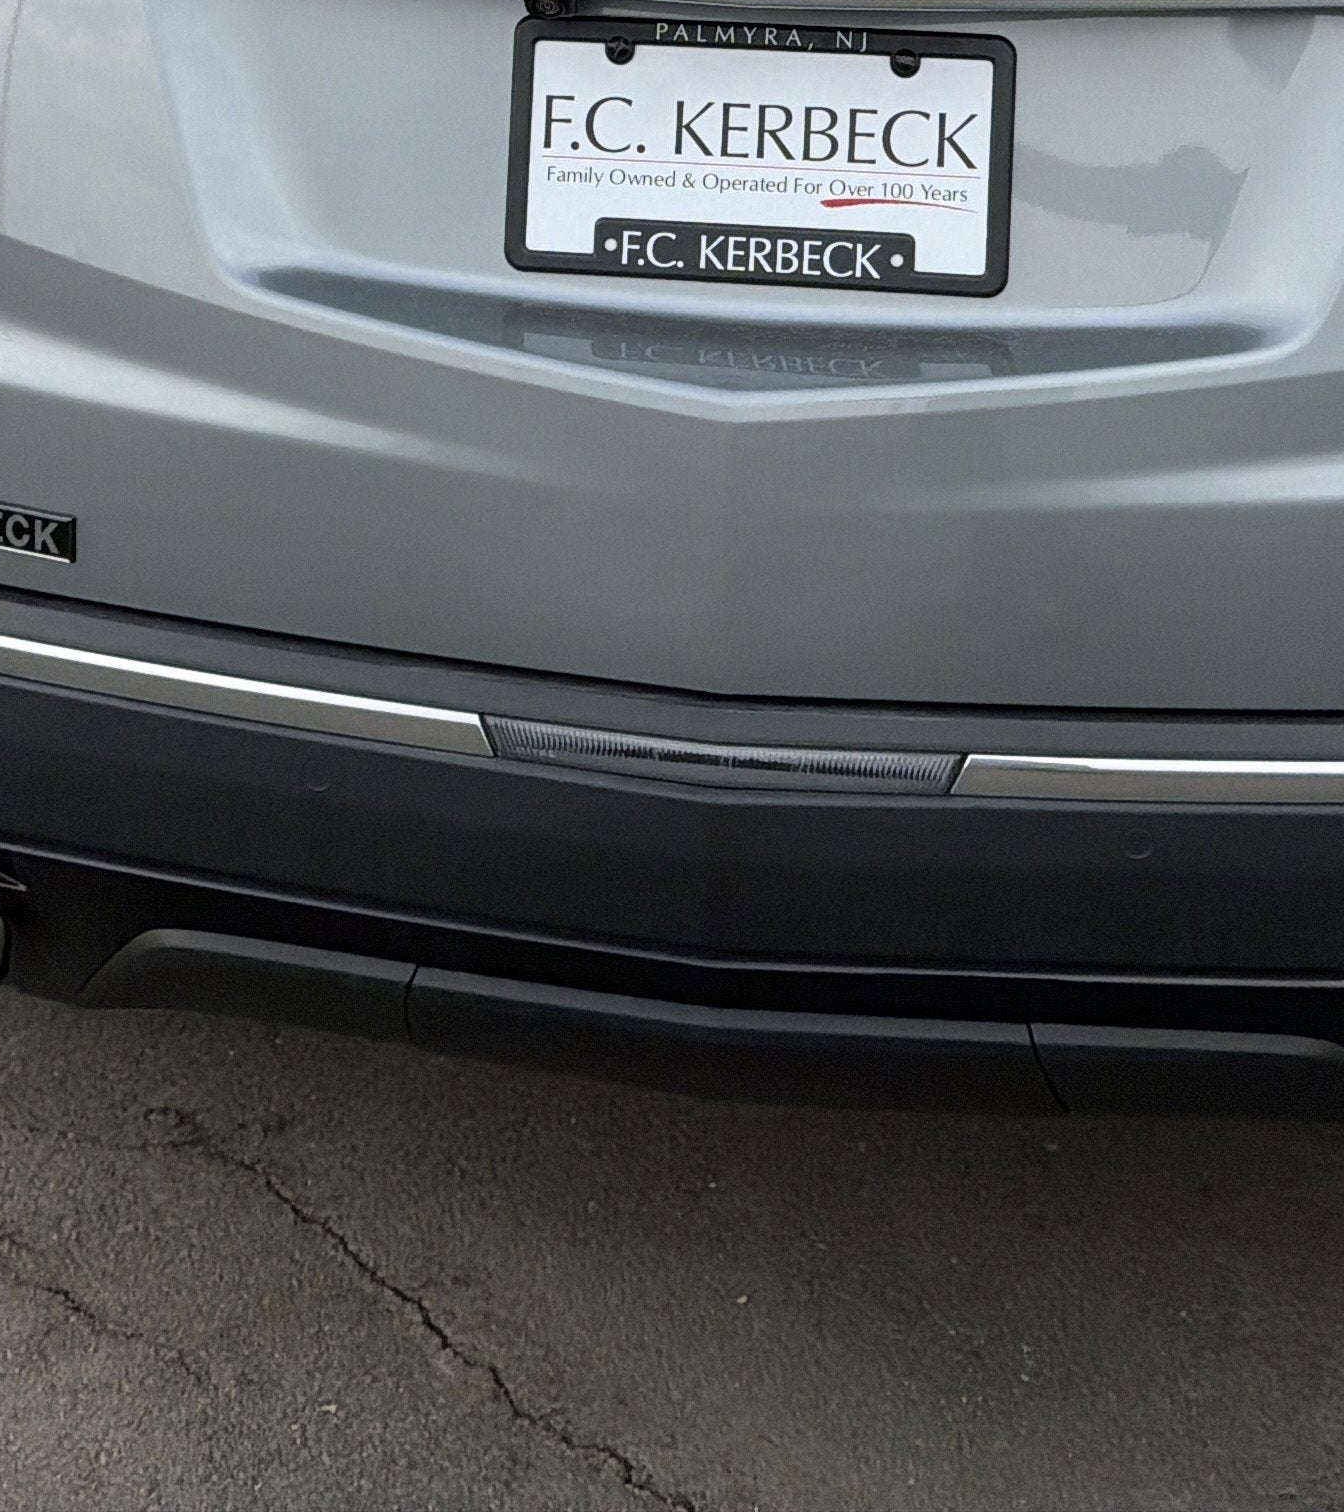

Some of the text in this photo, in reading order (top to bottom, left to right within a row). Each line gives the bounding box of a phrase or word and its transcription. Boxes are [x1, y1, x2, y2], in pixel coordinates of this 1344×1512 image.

[655, 22, 870, 53] PALMYRA, NJ
[542, 94, 979, 170] F.C. KERBECK
[546, 165, 968, 203] Family Owned & Operated For Over 100 Years
[620, 230, 882, 279] F.C. KERBECK
